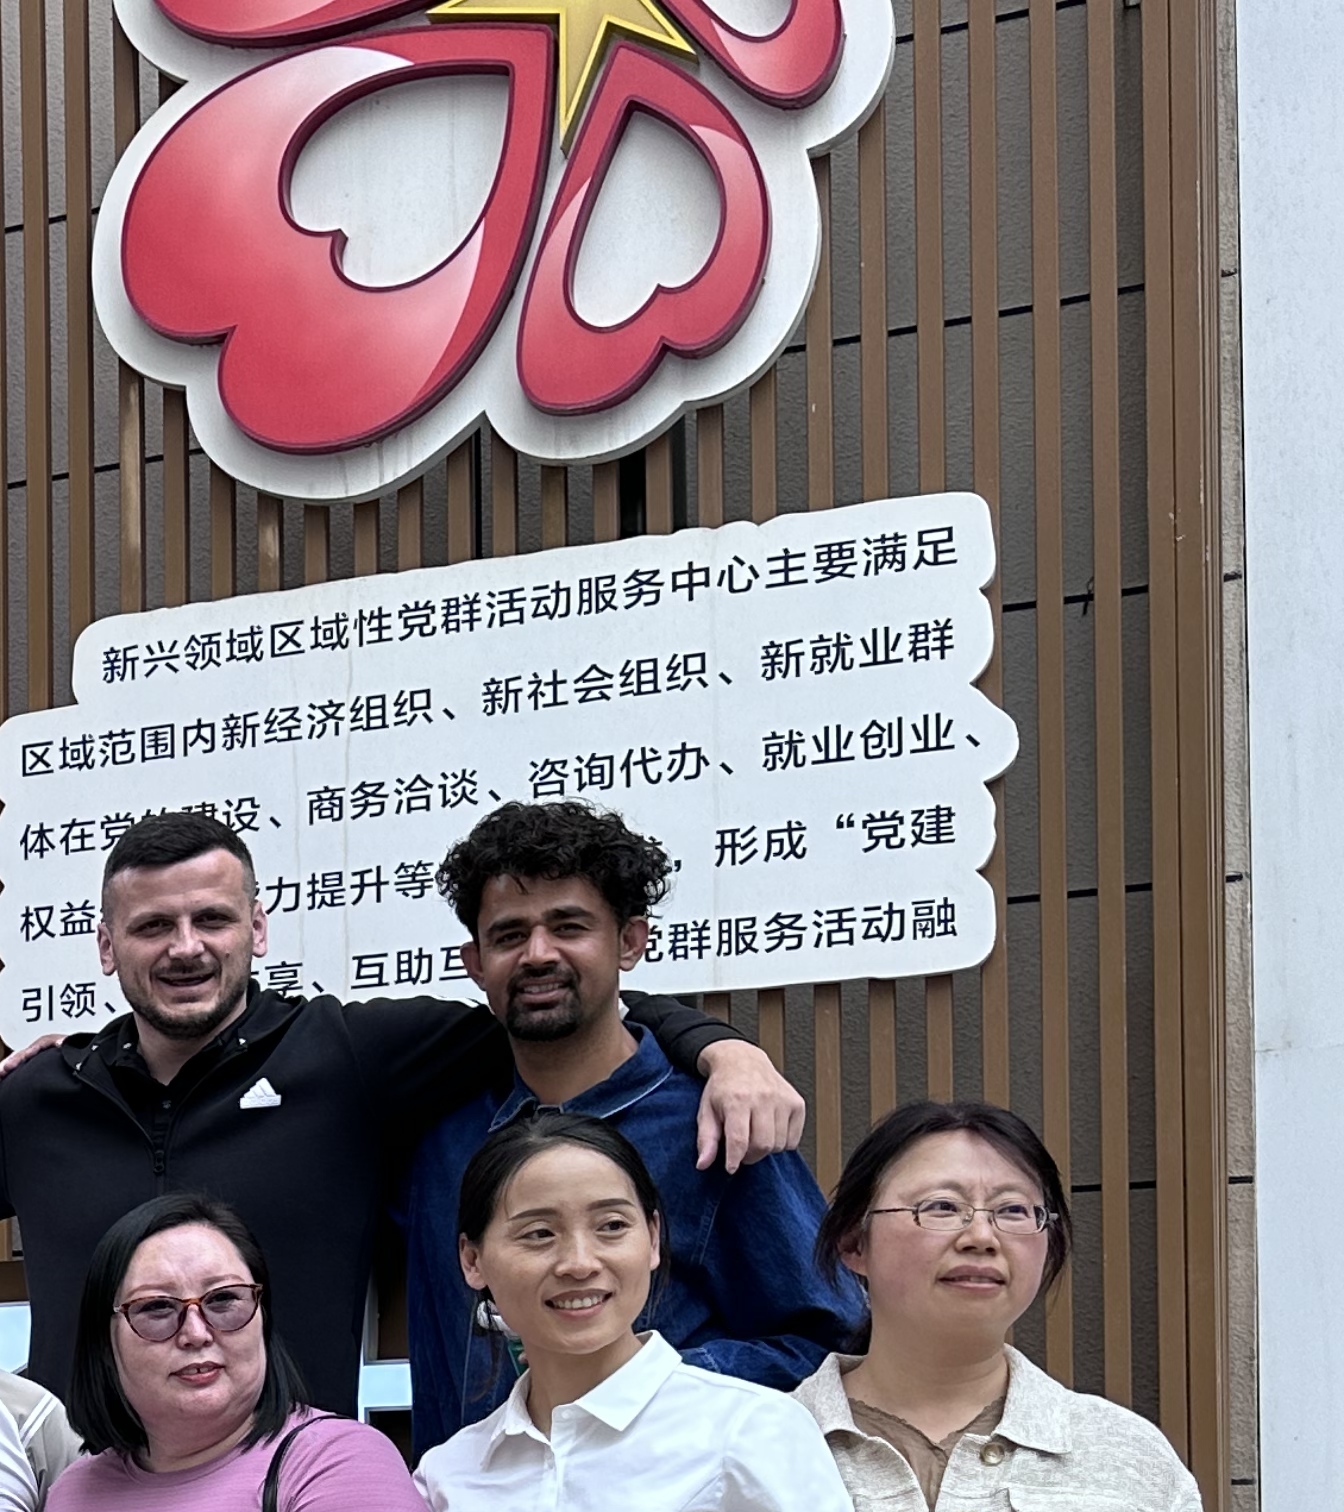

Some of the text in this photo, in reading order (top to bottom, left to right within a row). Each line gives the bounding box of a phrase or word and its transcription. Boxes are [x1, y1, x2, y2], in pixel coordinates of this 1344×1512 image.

[101, 525, 959, 684] 新兴领域区域性党群活动服务中心主要满足
[20, 617, 956, 778] 区域范围内新经济组织、新社会组织、新就业群
[19, 712, 982, 862] 体在党设、商务洽谈、咨询代办、就业创业、
